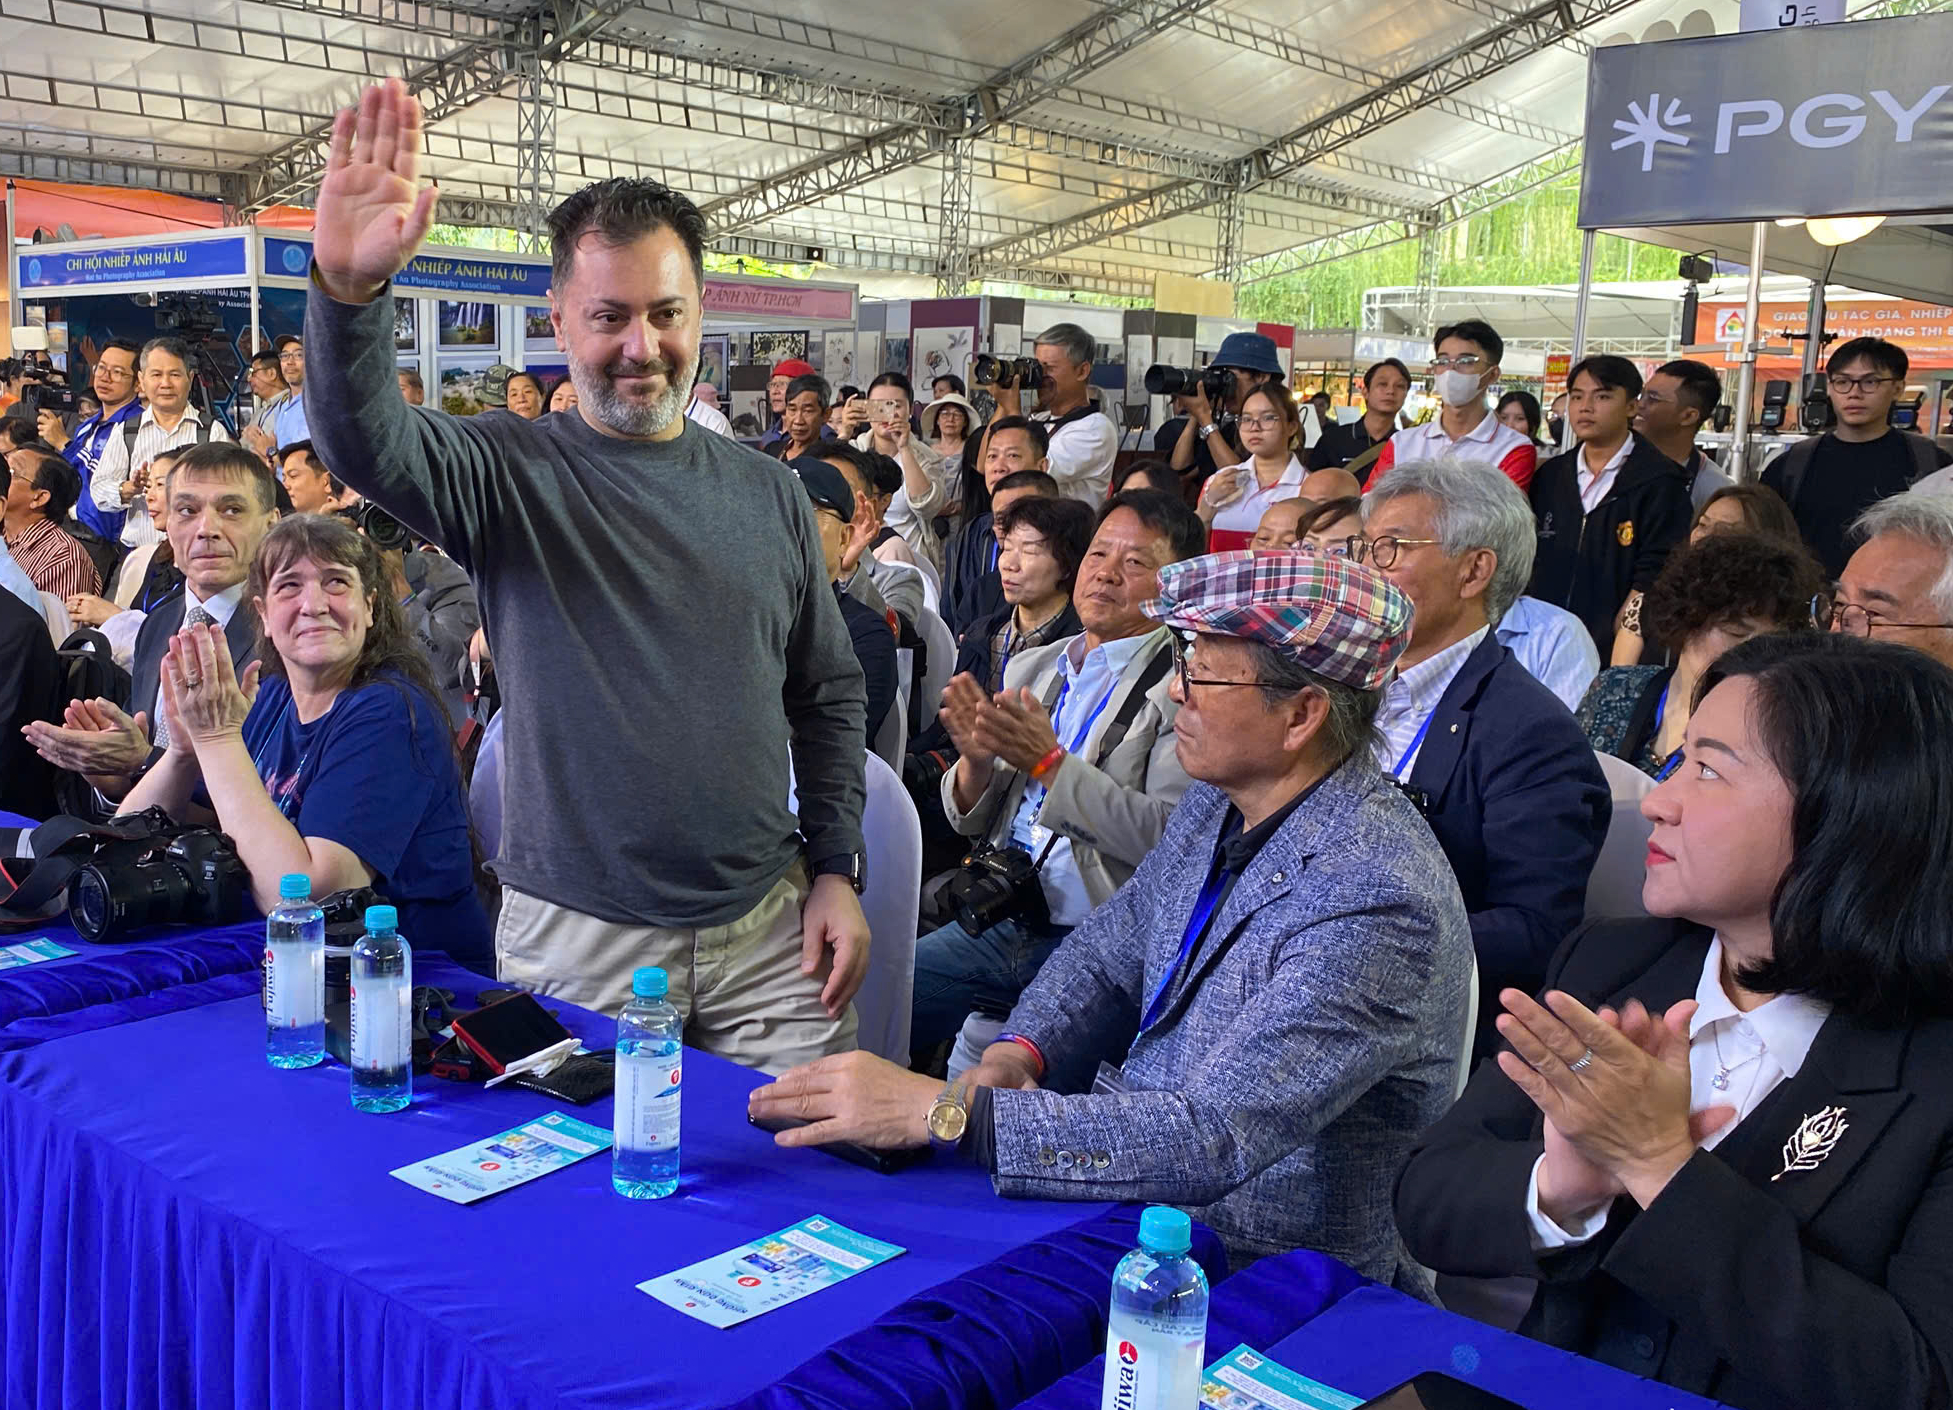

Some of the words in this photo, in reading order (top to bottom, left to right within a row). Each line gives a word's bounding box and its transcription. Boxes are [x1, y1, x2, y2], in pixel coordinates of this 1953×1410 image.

[1714, 85, 1952, 154] PGY
[66, 258, 82, 271] CHI
[84, 253, 102, 273] HỘI
[103, 249, 131, 268] NHIẾP
[132, 248, 153, 266] ẢNH
[154, 246, 171, 265] HẢI
[173, 247, 187, 263] ÂU
[412, 258, 452, 275] NHIẾP
[454, 262, 482, 278] ẢNH
[486, 265, 507, 279] HẢI
[510, 267, 528, 282] ÂU
[103, 271, 135, 281] Photography
[136, 269, 166, 279] Association
[411, 276, 458, 289] Photography
[460, 281, 501, 291] Association
